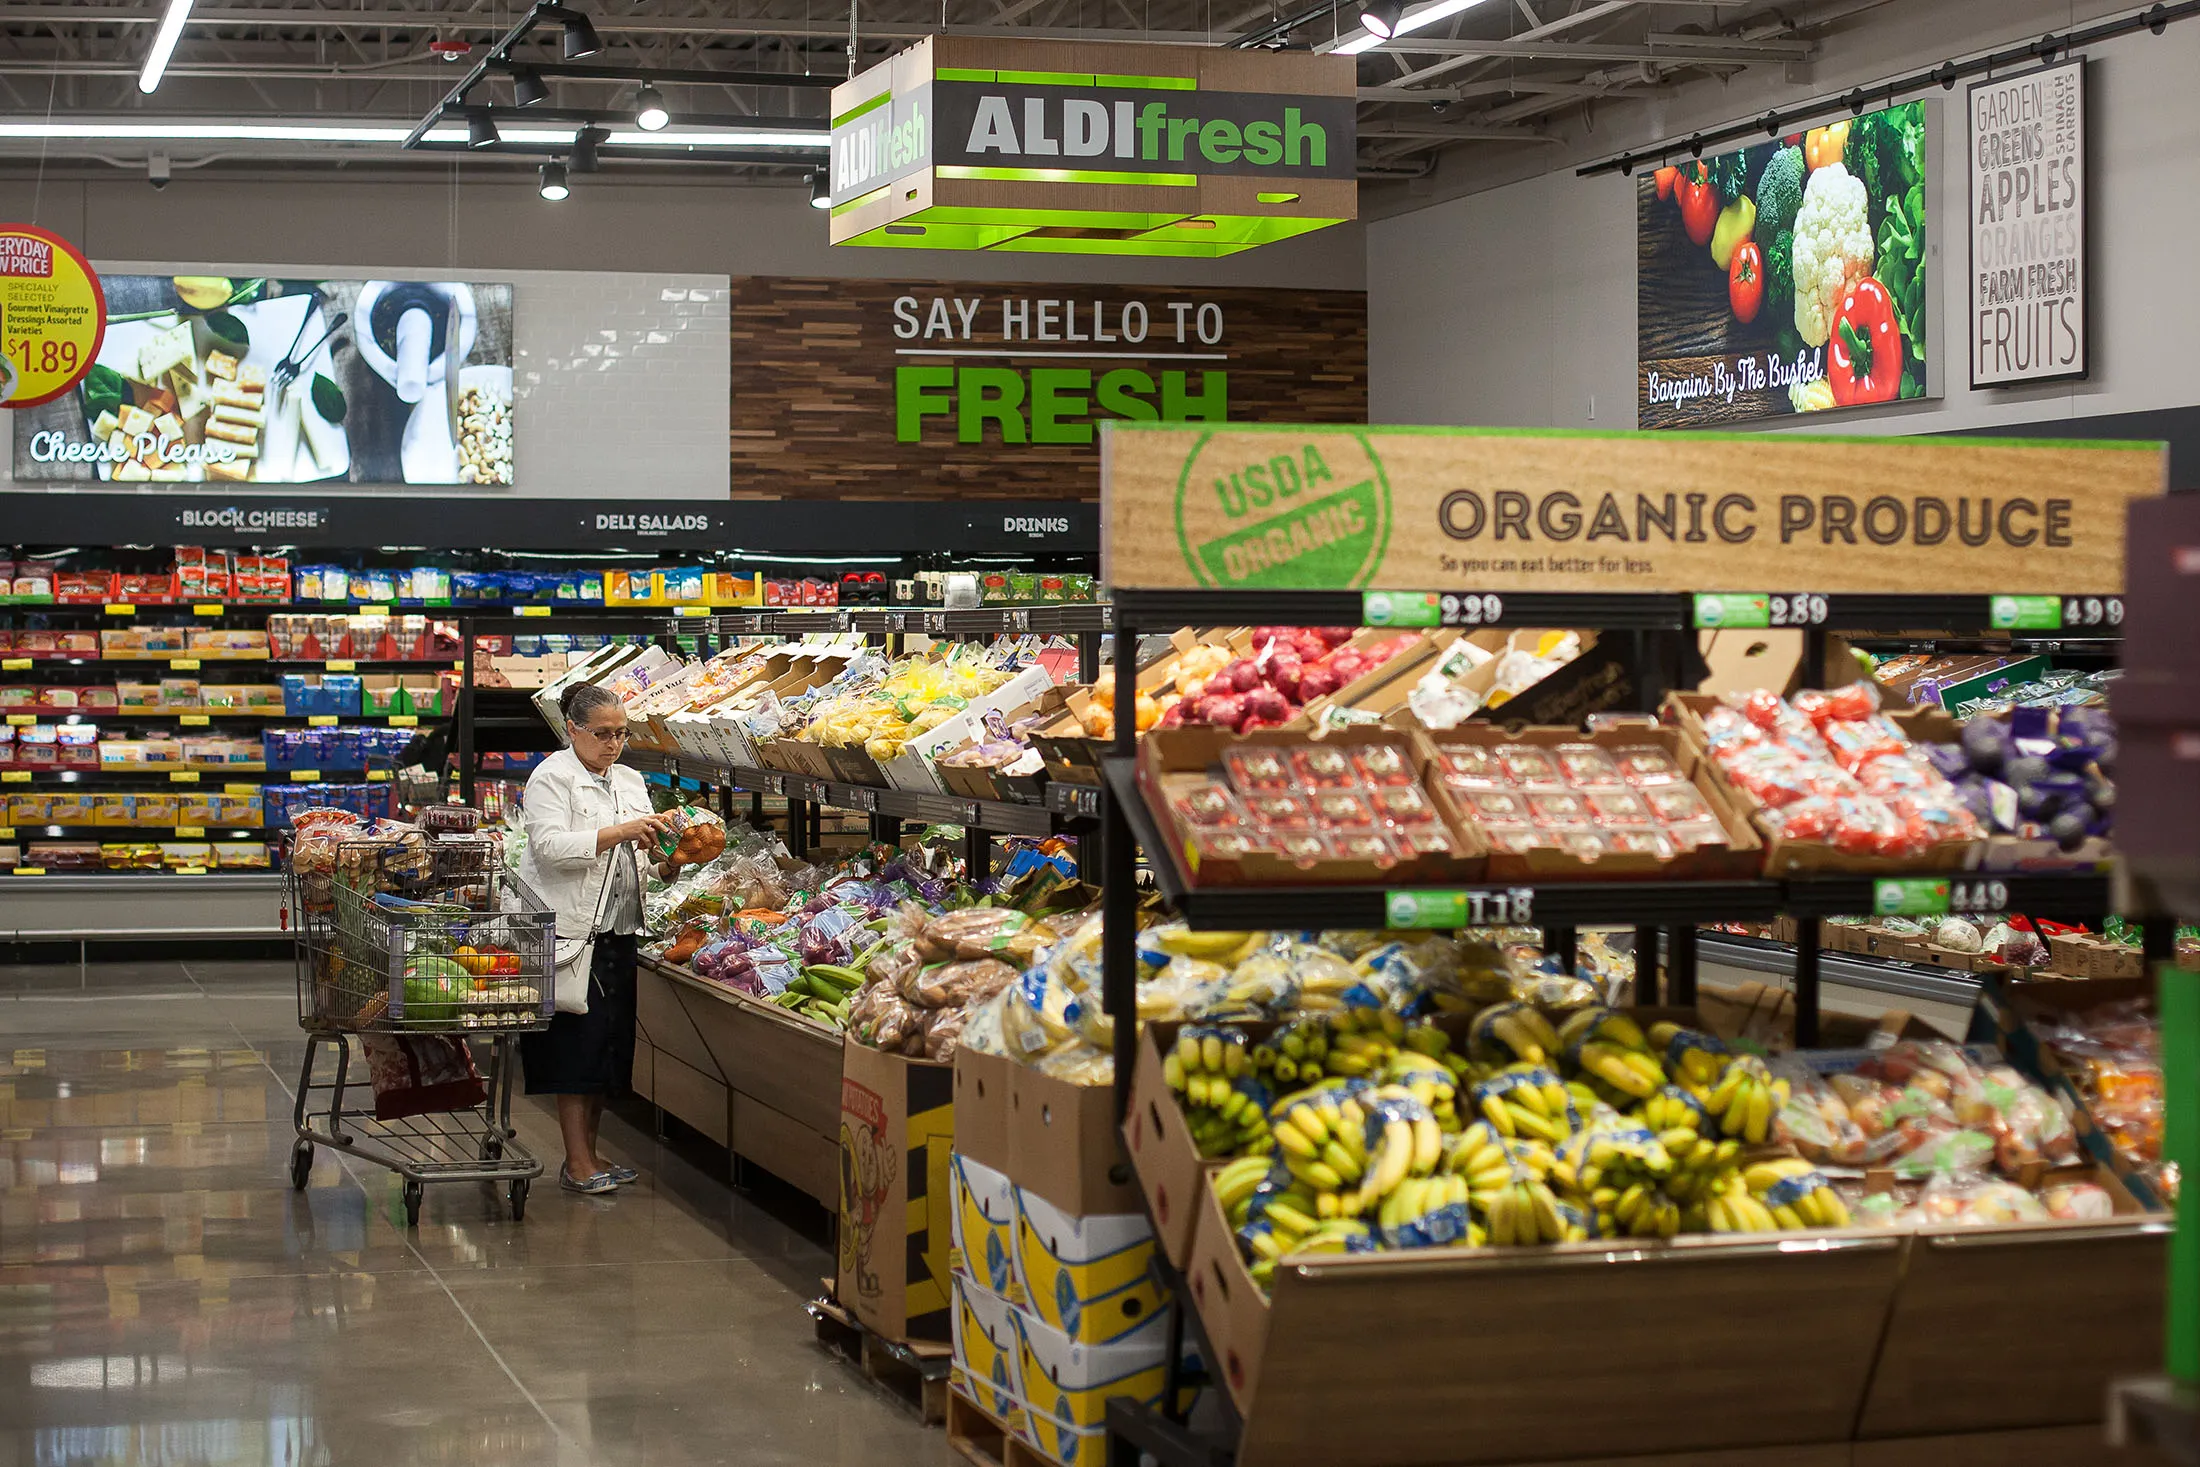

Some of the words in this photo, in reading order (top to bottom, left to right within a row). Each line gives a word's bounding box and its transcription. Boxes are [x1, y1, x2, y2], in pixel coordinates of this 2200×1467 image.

[1976, 81, 2043, 132] GARDEN
[2055, 76, 2066, 155] SPINACH
[2065, 73, 2076, 153] CARROTS
[966, 95, 1328, 167] ALDIfresh
[1978, 122, 2045, 172] GREENS
[1979, 156, 2076, 225] APPLES
[1980, 211, 2077, 269] ORANGES
[8, 282, 59, 292] SPECIALLY
[11, 256, 49, 275] PRICE
[1979, 267, 2025, 306] FARM
[2028, 258, 2078, 299] FRESH
[8, 293, 55, 302] SELECTED
[8, 303, 42, 313] Gourmet
[44, 304, 89, 315] Vinaigrette
[8, 315, 46, 327] Dressings
[47, 316, 82, 325] Assorted
[893, 296, 980, 340] SAY
[1003, 299, 1148, 343] HELLO
[1168, 302, 1224, 344] TO
[8, 326, 43, 335] Varieties
[1979, 296, 2078, 376] FRUITS
[8, 338, 78, 374] $1.89
[1647, 371, 1712, 410] Bargains
[1713, 361, 1737, 403] By
[1738, 356, 1766, 391] The
[1768, 347, 1824, 388] Bushel
[30, 430, 130, 463] Cheese
[132, 431, 238, 464] Please
[1214, 444, 1333, 519] USDA
[182, 510, 245, 528] BLOCK
[248, 511, 318, 528] CHEESE
[596, 514, 636, 530] DELI
[639, 515, 709, 531] SALADS
[1004, 517, 1069, 532] DRINKS
[1223, 498, 1367, 581] ORGANIC
[1439, 489, 1757, 543] ORGANIC
[1780, 494, 2073, 547] PRODUCE
[1439, 554, 1459, 571] So
[1461, 559, 1490, 577] you
[1491, 559, 1517, 571] can
[1521, 557, 1544, 572] eat
[1549, 556, 1595, 573] better
[1598, 556, 1621, 573] for
